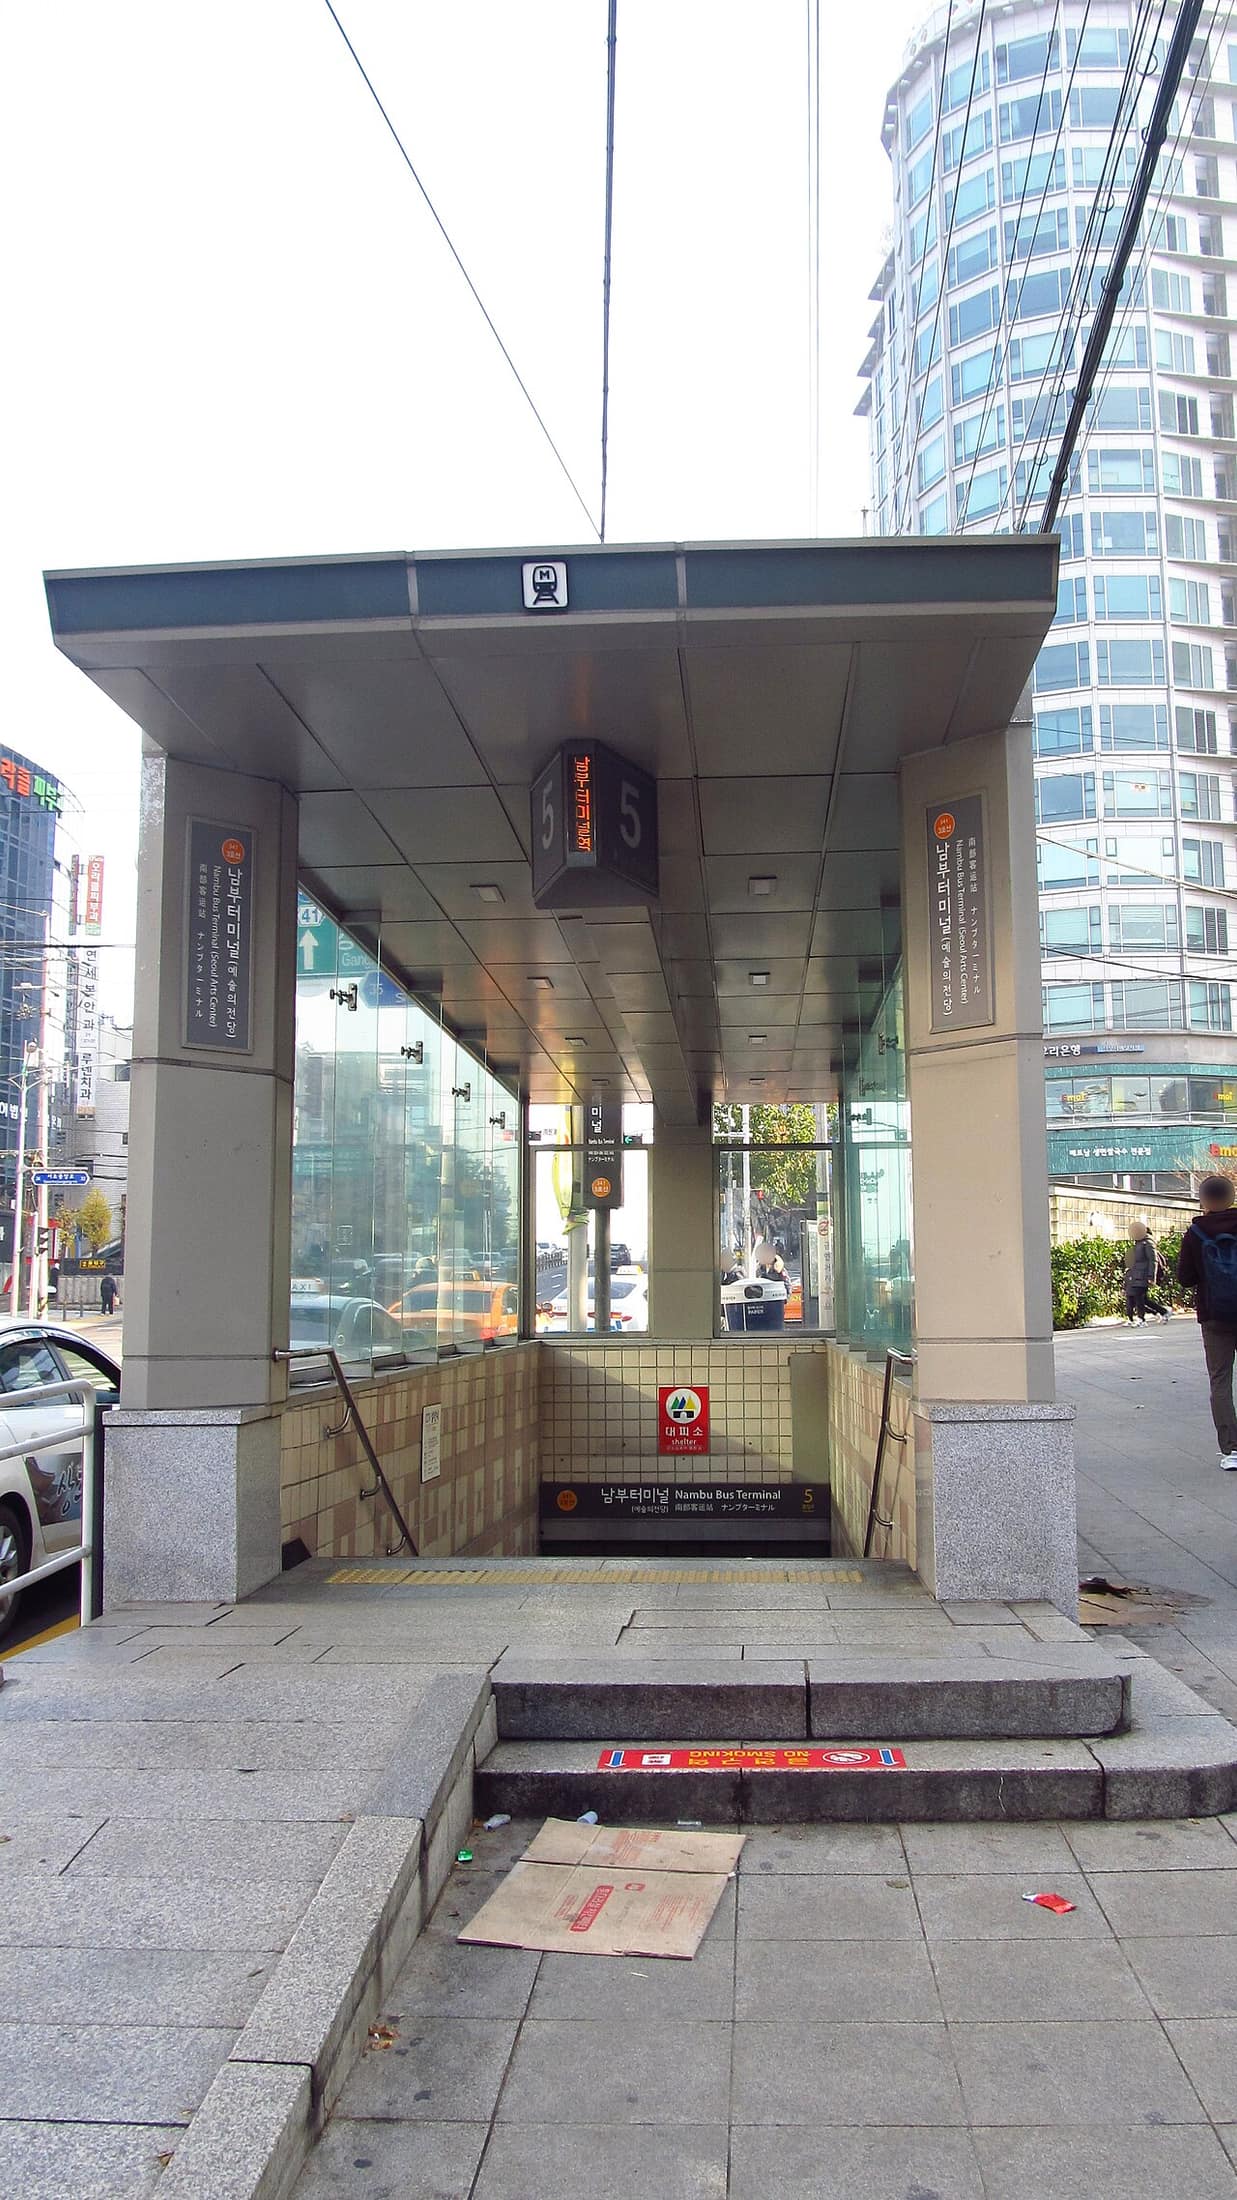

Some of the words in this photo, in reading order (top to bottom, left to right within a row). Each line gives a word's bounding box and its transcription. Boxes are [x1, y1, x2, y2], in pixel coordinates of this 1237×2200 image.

[541, 780, 555, 850] 5
[619, 780, 641, 850] 5
[955, 839, 965, 870] Nambu
[212, 865, 222, 896] Nambu
[957, 871, 965, 887] Bus
[212, 897, 221, 912] Bus
[957, 887, 967, 925] Terminal
[210, 914, 220, 949] Terminal
[960, 954, 968, 972] Arts
[209, 979, 219, 996] Arts
[665, 1426, 704, 1437] 대피소
[671, 1438, 697, 1446] shelter
[601, 1487, 669, 1504] 남부터미널
[675, 1489, 714, 1500] Nambu
[715, 1489, 735, 1500] Bus
[735, 1489, 781, 1500] Terminal
[803, 1488, 813, 1504] 5
[721, 1503, 775, 1512] ナンブターミナル
